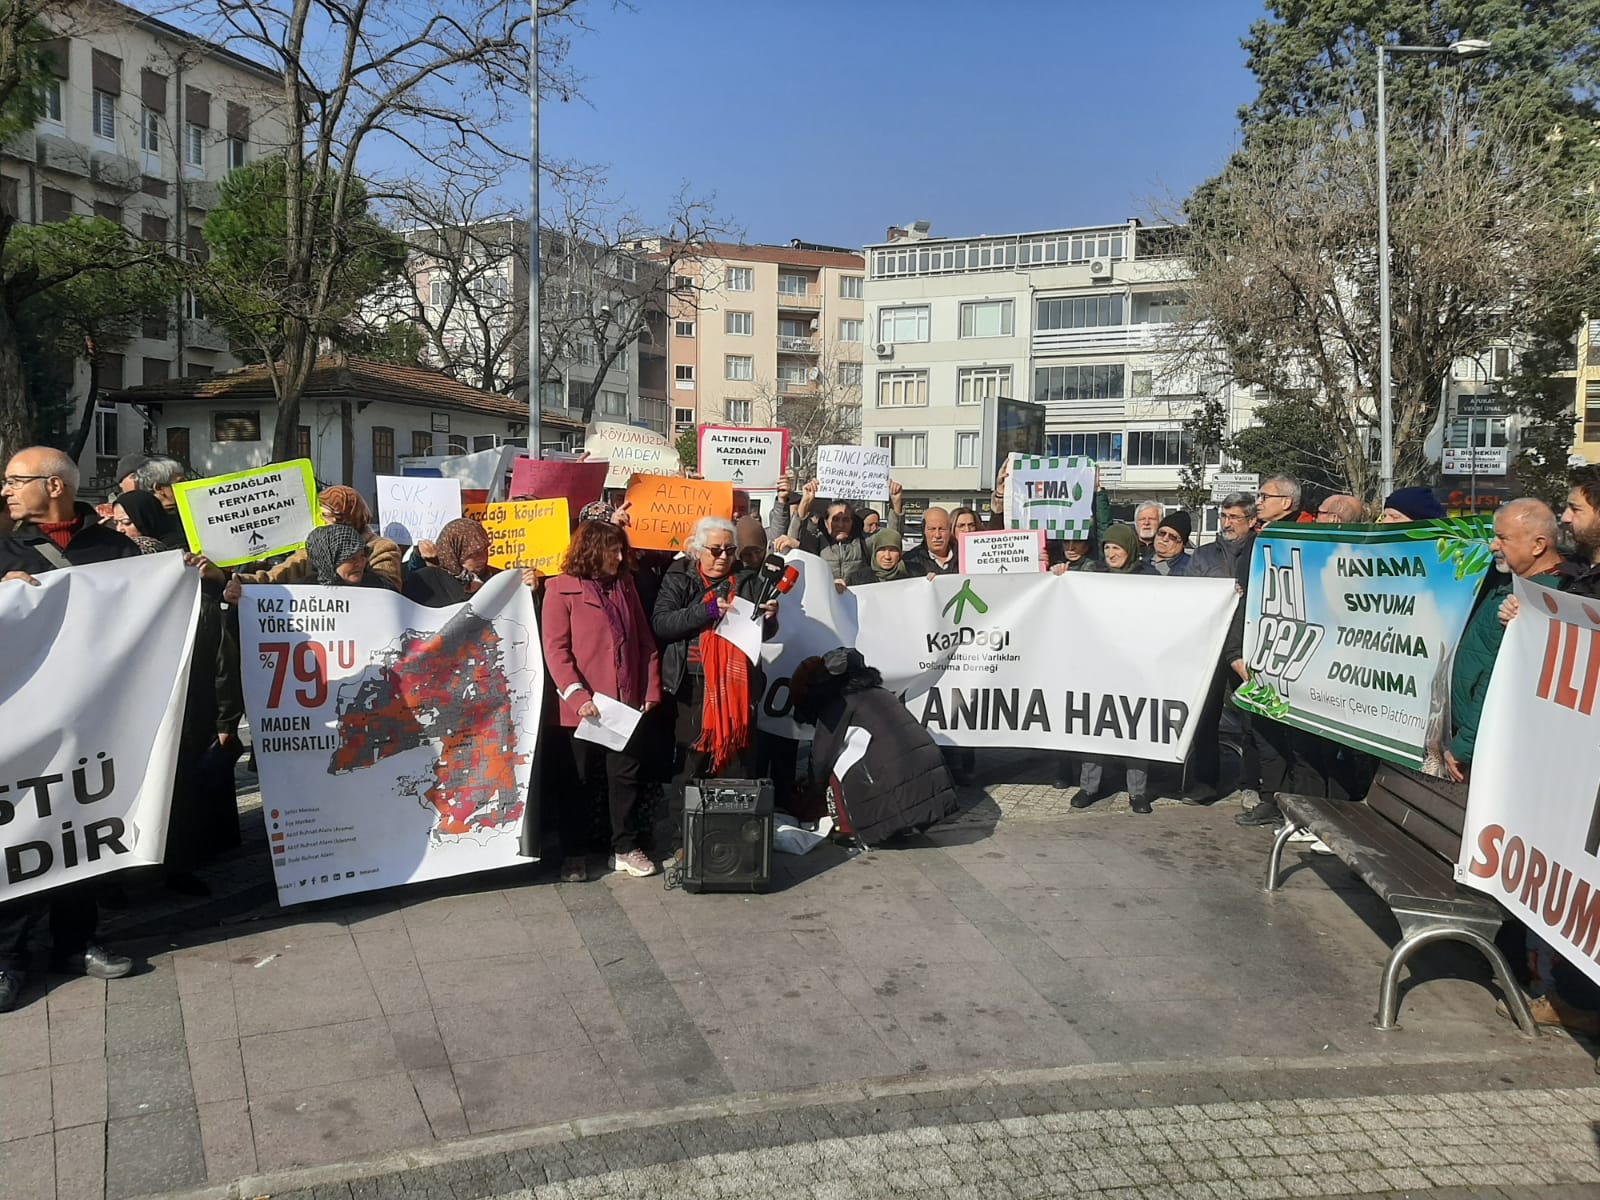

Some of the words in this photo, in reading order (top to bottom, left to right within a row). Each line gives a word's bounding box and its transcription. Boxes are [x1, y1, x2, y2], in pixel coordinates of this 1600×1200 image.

[711, 435, 747, 443] ALTINCI
[612, 446, 661, 462] MADEN
[716, 446, 766, 455] KAZDAĞINI
[721, 458, 760, 466] TERKET!
[208, 474, 282, 496] KAZDAĞLARI
[656, 483, 712, 501] ALTIN
[1025, 480, 1069, 499] TEMA
[219, 489, 279, 508] FERYATTA,
[207, 507, 250, 525] ENERJİ
[252, 498, 295, 515] BAKANI
[514, 502, 555, 522] köyleri
[230, 515, 281, 534] NEREDE?
[489, 540, 526, 557] sahip
[981, 549, 1024, 557] ALTINDAN
[991, 542, 1014, 550] ÜSTÜ
[977, 556, 1029, 565] DEĞERLİDİR
[1337, 556, 1427, 578] HAVAMA
[258, 598, 284, 613] KAZ
[290, 596, 350, 613] DAĞLARI
[1344, 593, 1416, 616] SUYUMA
[258, 615, 336, 633] YÖRESİNİN
[926, 626, 1010, 653] KazDağı
[1337, 626, 1428, 659] TOPRAĞIMA
[982, 653, 1021, 661] Varlıkları
[963, 664, 998, 674] Derneği
[1327, 661, 1417, 698] DOKUNMA
[900, 686, 1051, 732] ANINA
[1064, 690, 1189, 745] HAYIR
[1310, 688, 1347, 709] Balıkesir
[1348, 698, 1378, 716] Çevre
[1381, 704, 1427, 730] Platformu
[261, 716, 310, 732] MADEN
[262, 735, 336, 753] RUHSATLI!
[4, 816, 130, 885] DİR
[1468, 824, 1600, 967] SORUM
